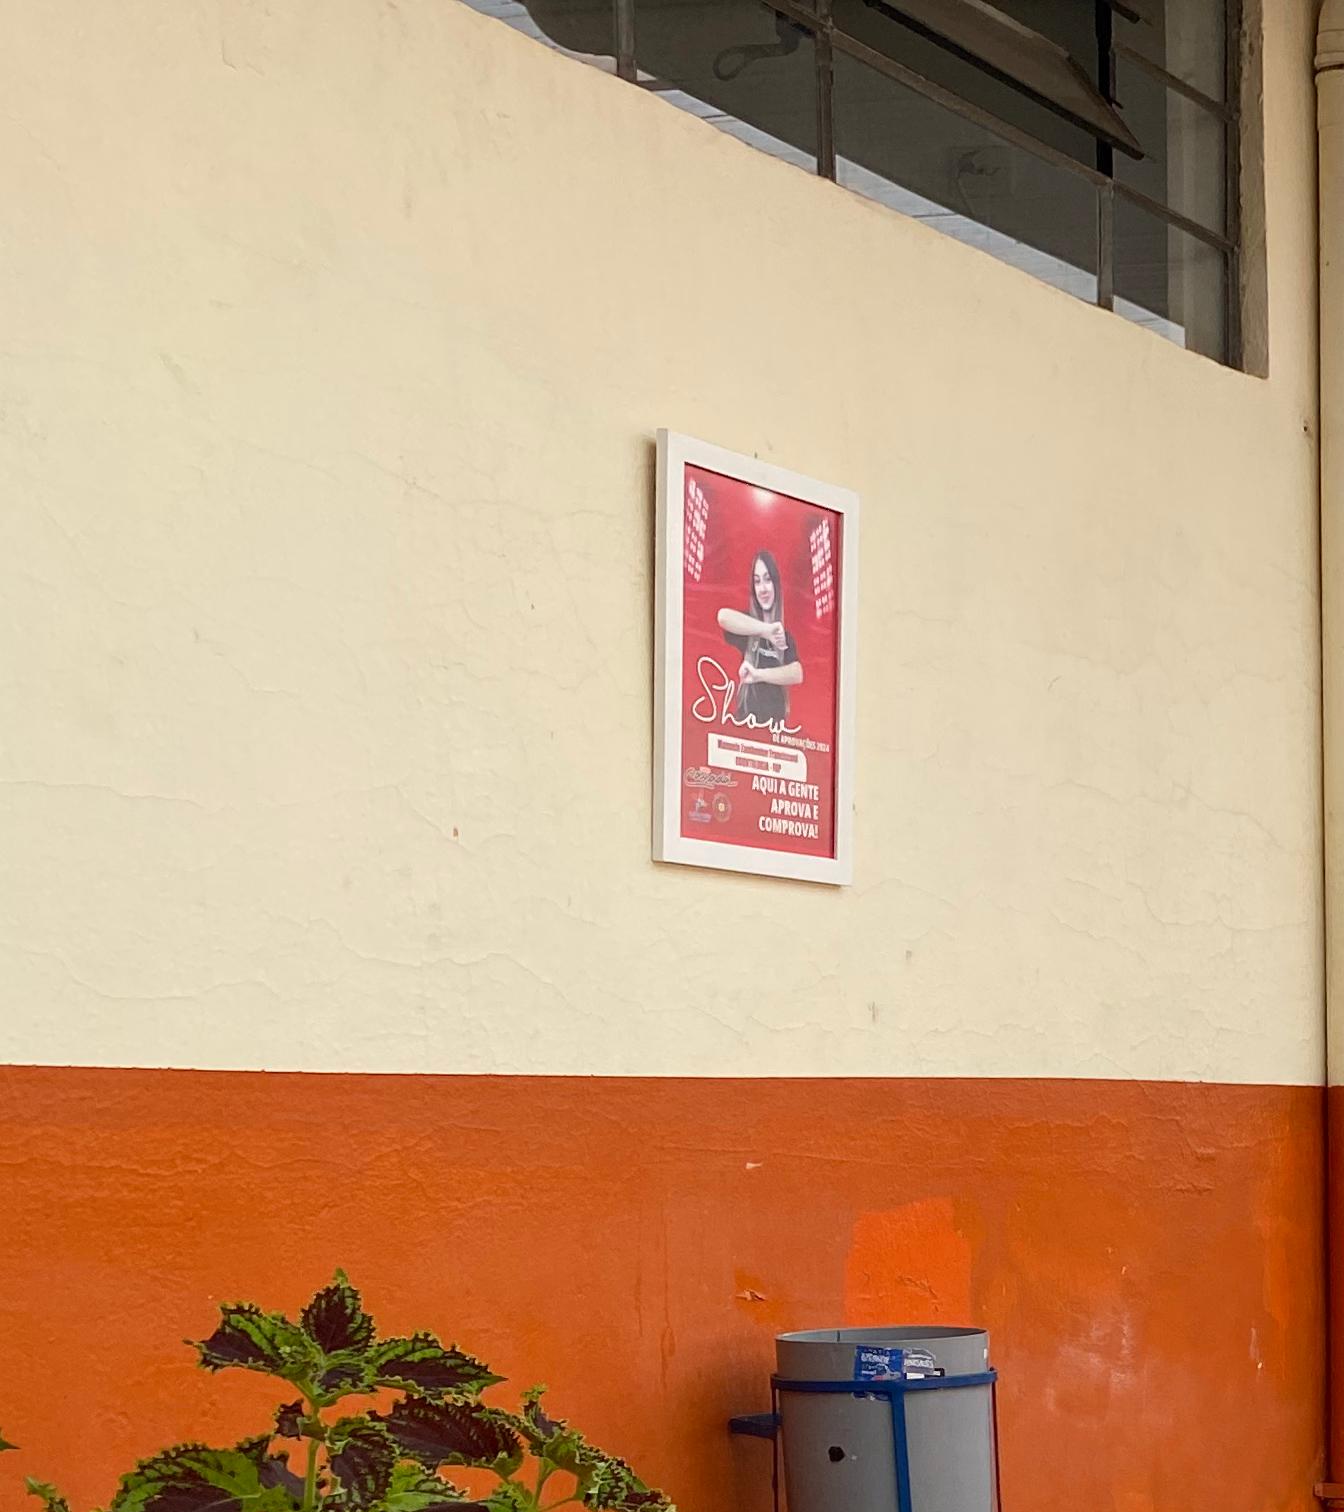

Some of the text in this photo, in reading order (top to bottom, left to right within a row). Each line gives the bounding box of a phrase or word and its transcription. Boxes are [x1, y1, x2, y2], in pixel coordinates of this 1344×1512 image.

[691, 655, 802, 734] Show
[752, 774, 778, 796] AQUI
[778, 780, 787, 795] A
[788, 782, 819, 801] GENTE
[771, 798, 819, 820] APROVA E
[758, 817, 819, 839] COMPROVA!
